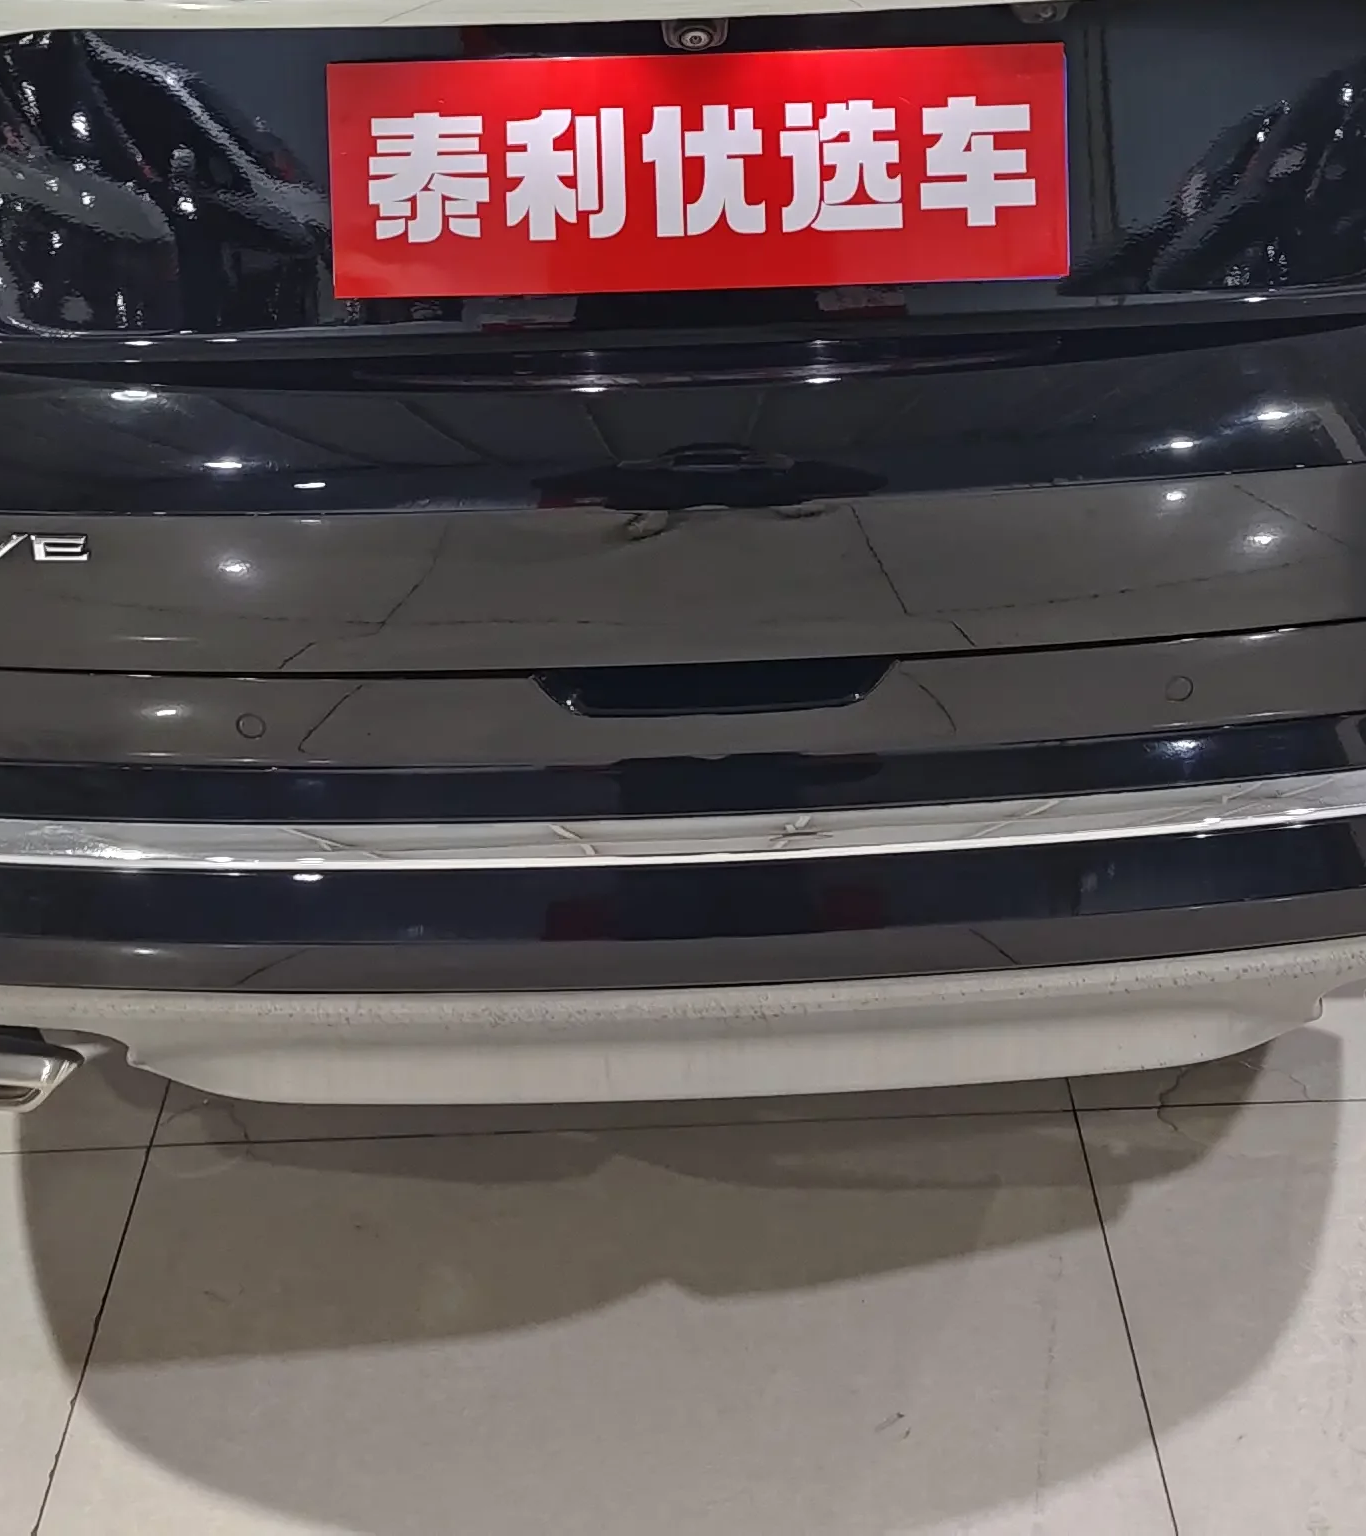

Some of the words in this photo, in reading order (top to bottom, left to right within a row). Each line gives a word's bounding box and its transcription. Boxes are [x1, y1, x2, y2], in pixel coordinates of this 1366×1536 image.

[367, 95, 1037, 245] 泰利优选车
